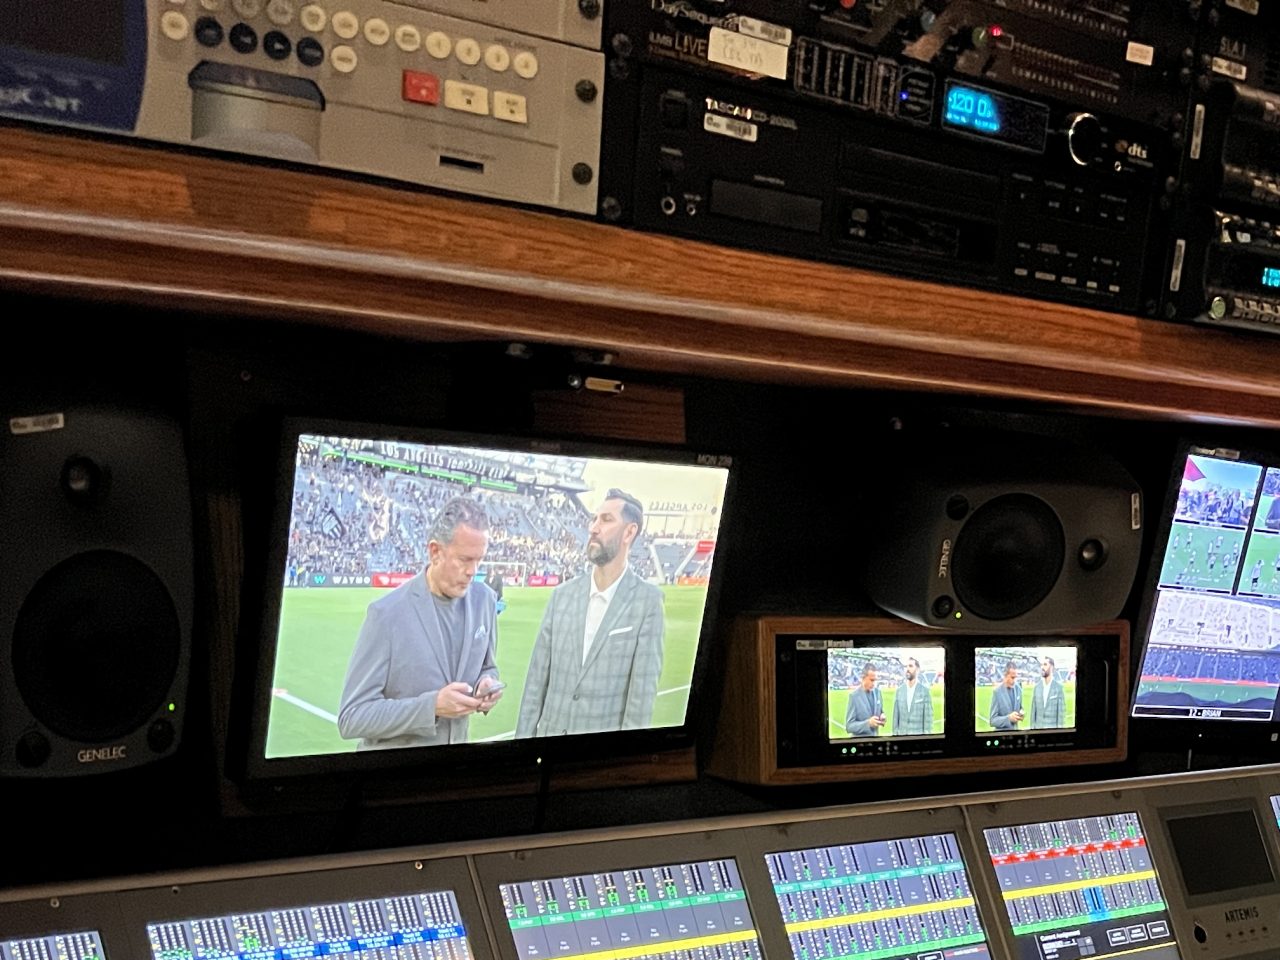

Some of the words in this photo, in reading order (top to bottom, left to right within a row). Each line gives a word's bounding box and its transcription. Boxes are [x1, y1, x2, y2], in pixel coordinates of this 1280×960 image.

[705, 97, 752, 120] TASCAM
[332, 576, 371, 584] WAYMO
[77, 746, 127, 763] GENELEC
[1224, 906, 1260, 924] ARTEMIS
